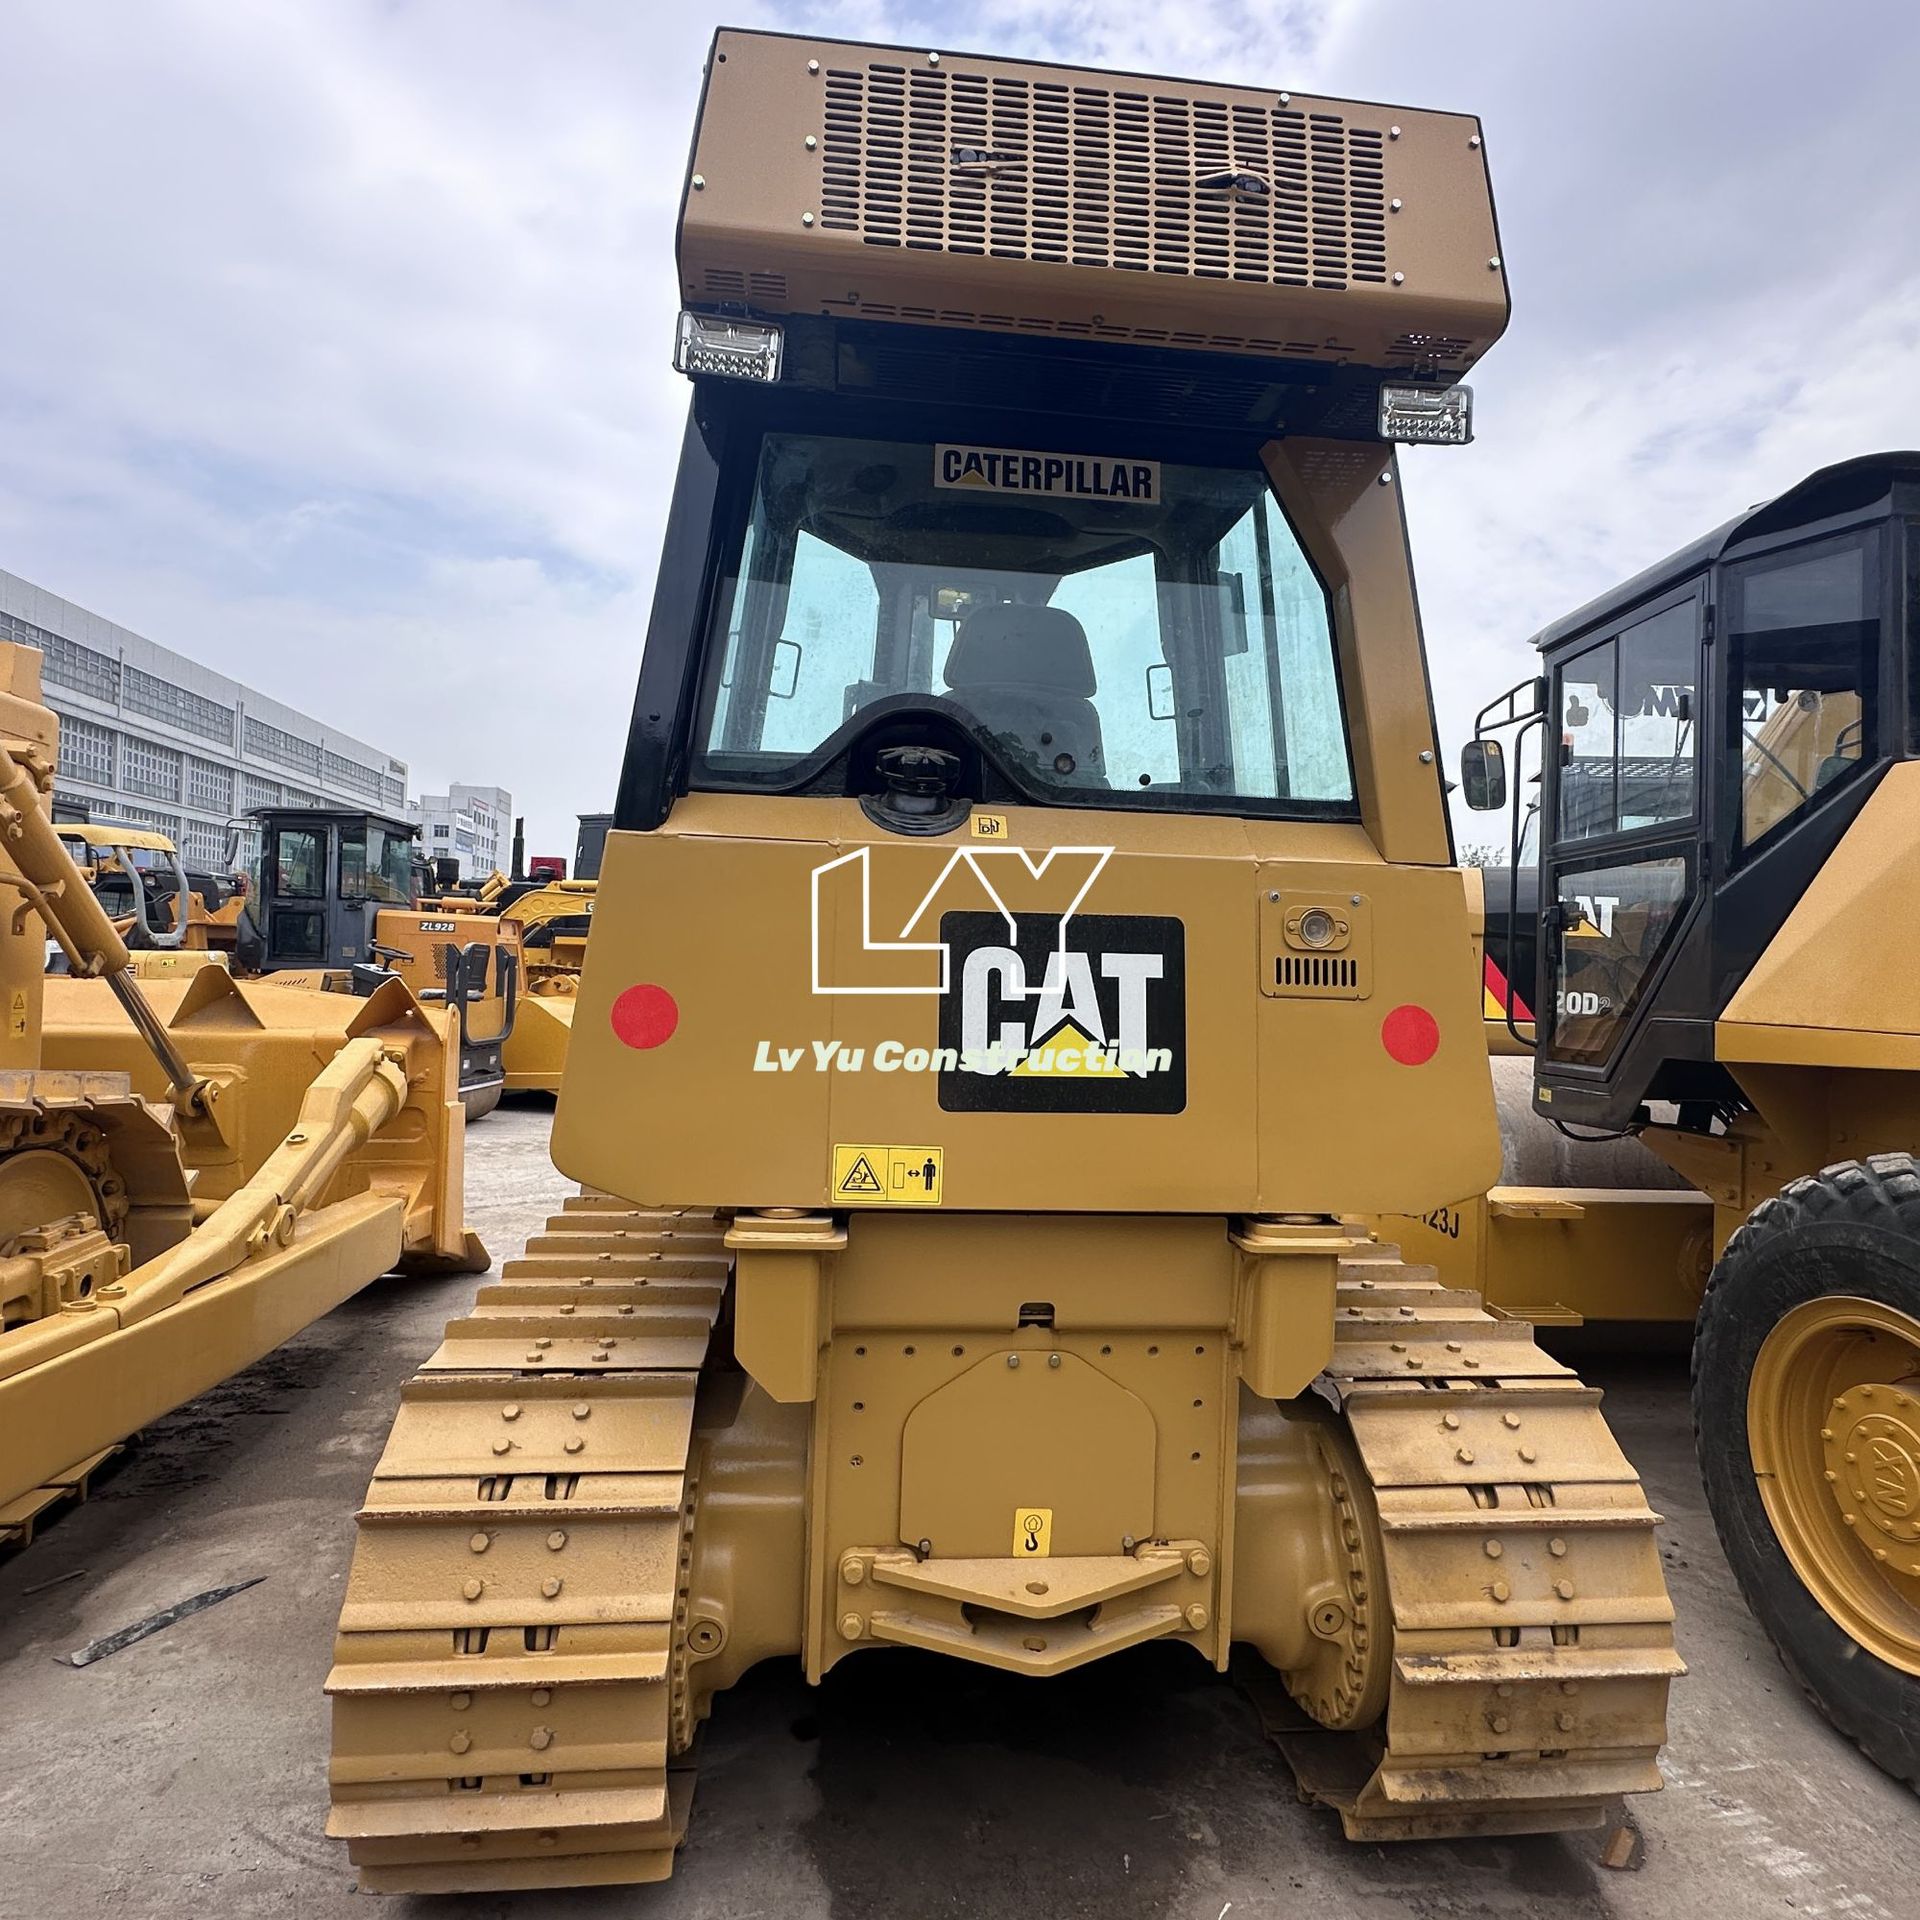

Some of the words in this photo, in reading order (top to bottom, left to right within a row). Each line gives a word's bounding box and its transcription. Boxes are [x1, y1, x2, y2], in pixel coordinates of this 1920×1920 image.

[943, 449, 1152, 498] CATERPILLAR
[420, 922, 455, 931] ZL928
[1558, 895, 1620, 938] AT
[962, 946, 1164, 1079] CAT
